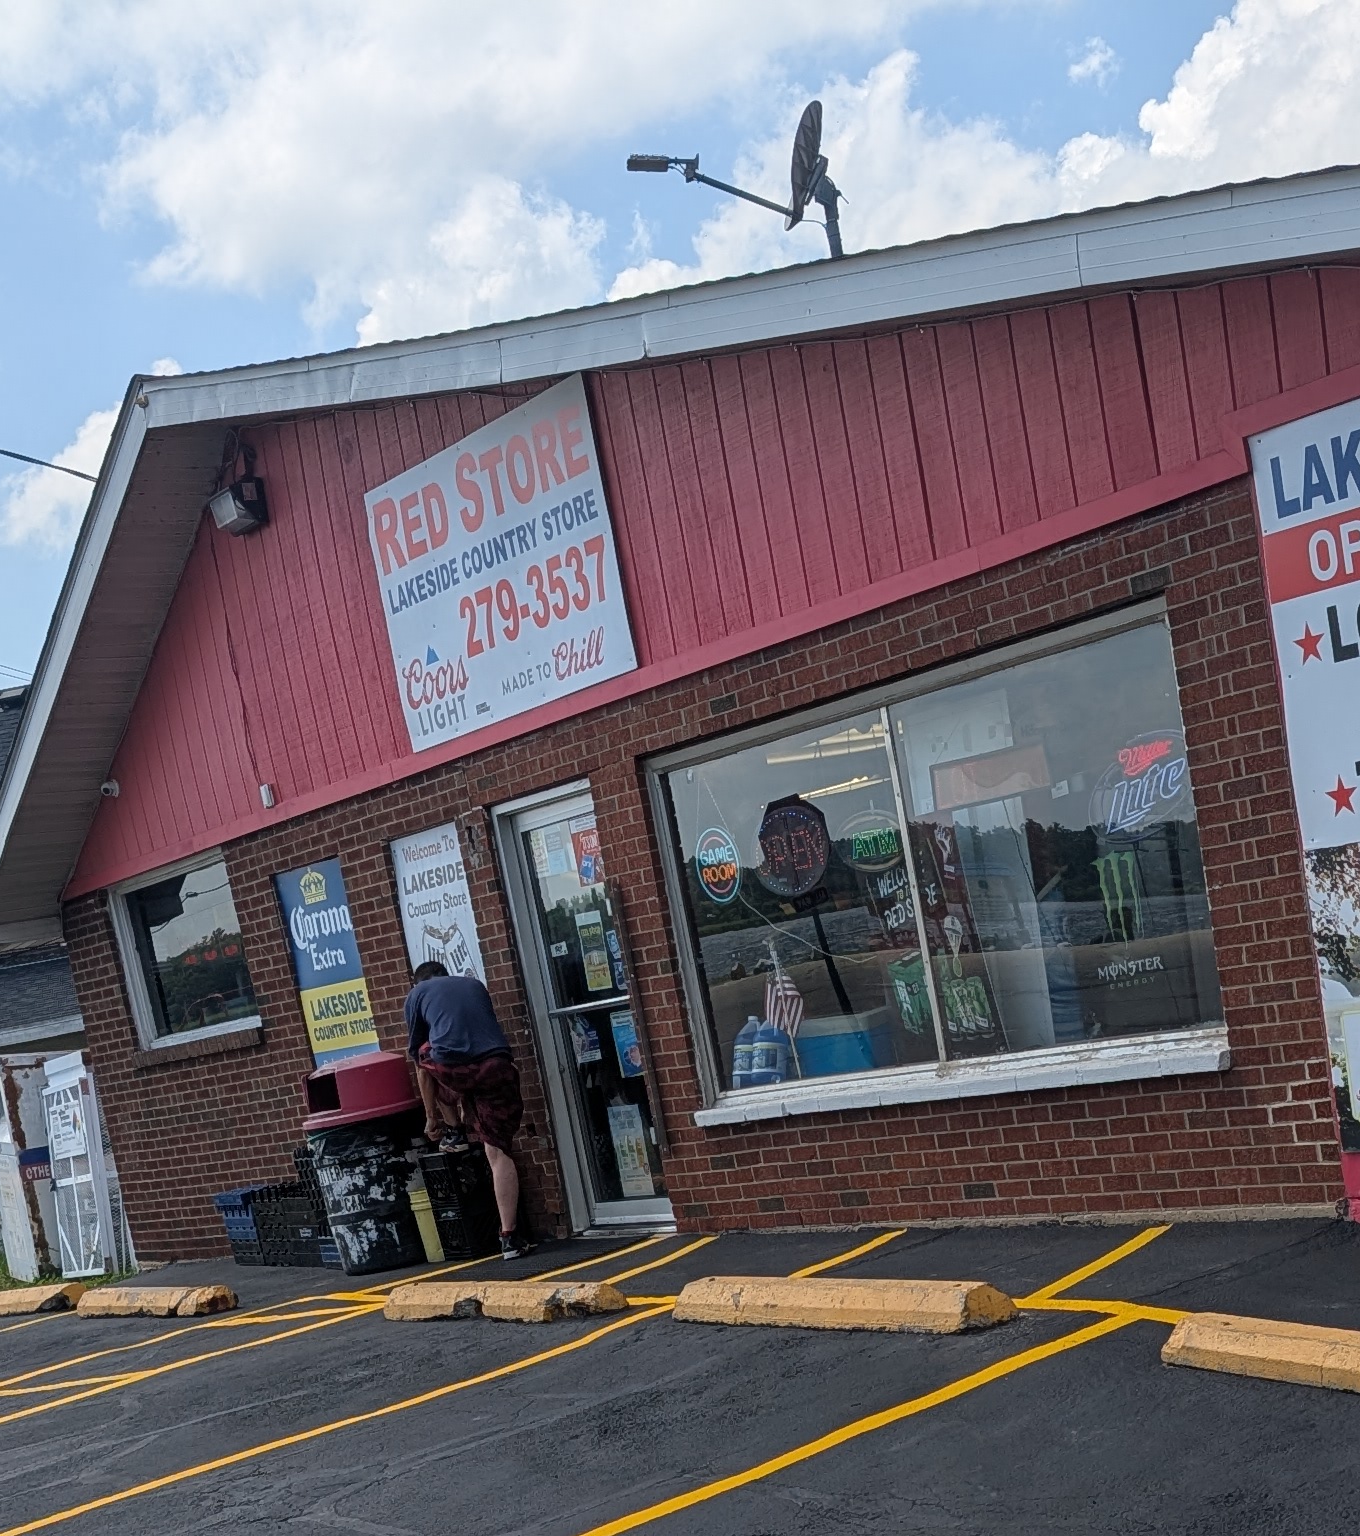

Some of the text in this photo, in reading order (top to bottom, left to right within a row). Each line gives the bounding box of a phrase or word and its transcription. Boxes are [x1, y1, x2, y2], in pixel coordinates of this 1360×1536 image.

[372, 408, 590, 576] RED STORE
[388, 489, 598, 615] LAKESIDE COUNTRY STORE
[460, 534, 605, 658] 279-3537
[502, 626, 605, 696] MADE TO Chill
[402, 655, 469, 710] Coors
[418, 694, 468, 736] LIGHT
[1118, 740, 1173, 776] Miller
[1106, 758, 1185, 835] Lite
[402, 835, 455, 863] Welcome To
[700, 845, 735, 866] GAME
[852, 827, 899, 859] ATM
[403, 861, 464, 895] LAKESIDE
[702, 863, 738, 884] ROOM
[407, 892, 468, 918] Country Store
[884, 903, 906, 931] RED
[290, 904, 353, 953] Corona
[311, 942, 346, 971] Extra
[1097, 956, 1164, 982] MONSTER
[310, 990, 367, 1021] LAKESIDE
[314, 1017, 375, 1042] COUNTRY STORE
